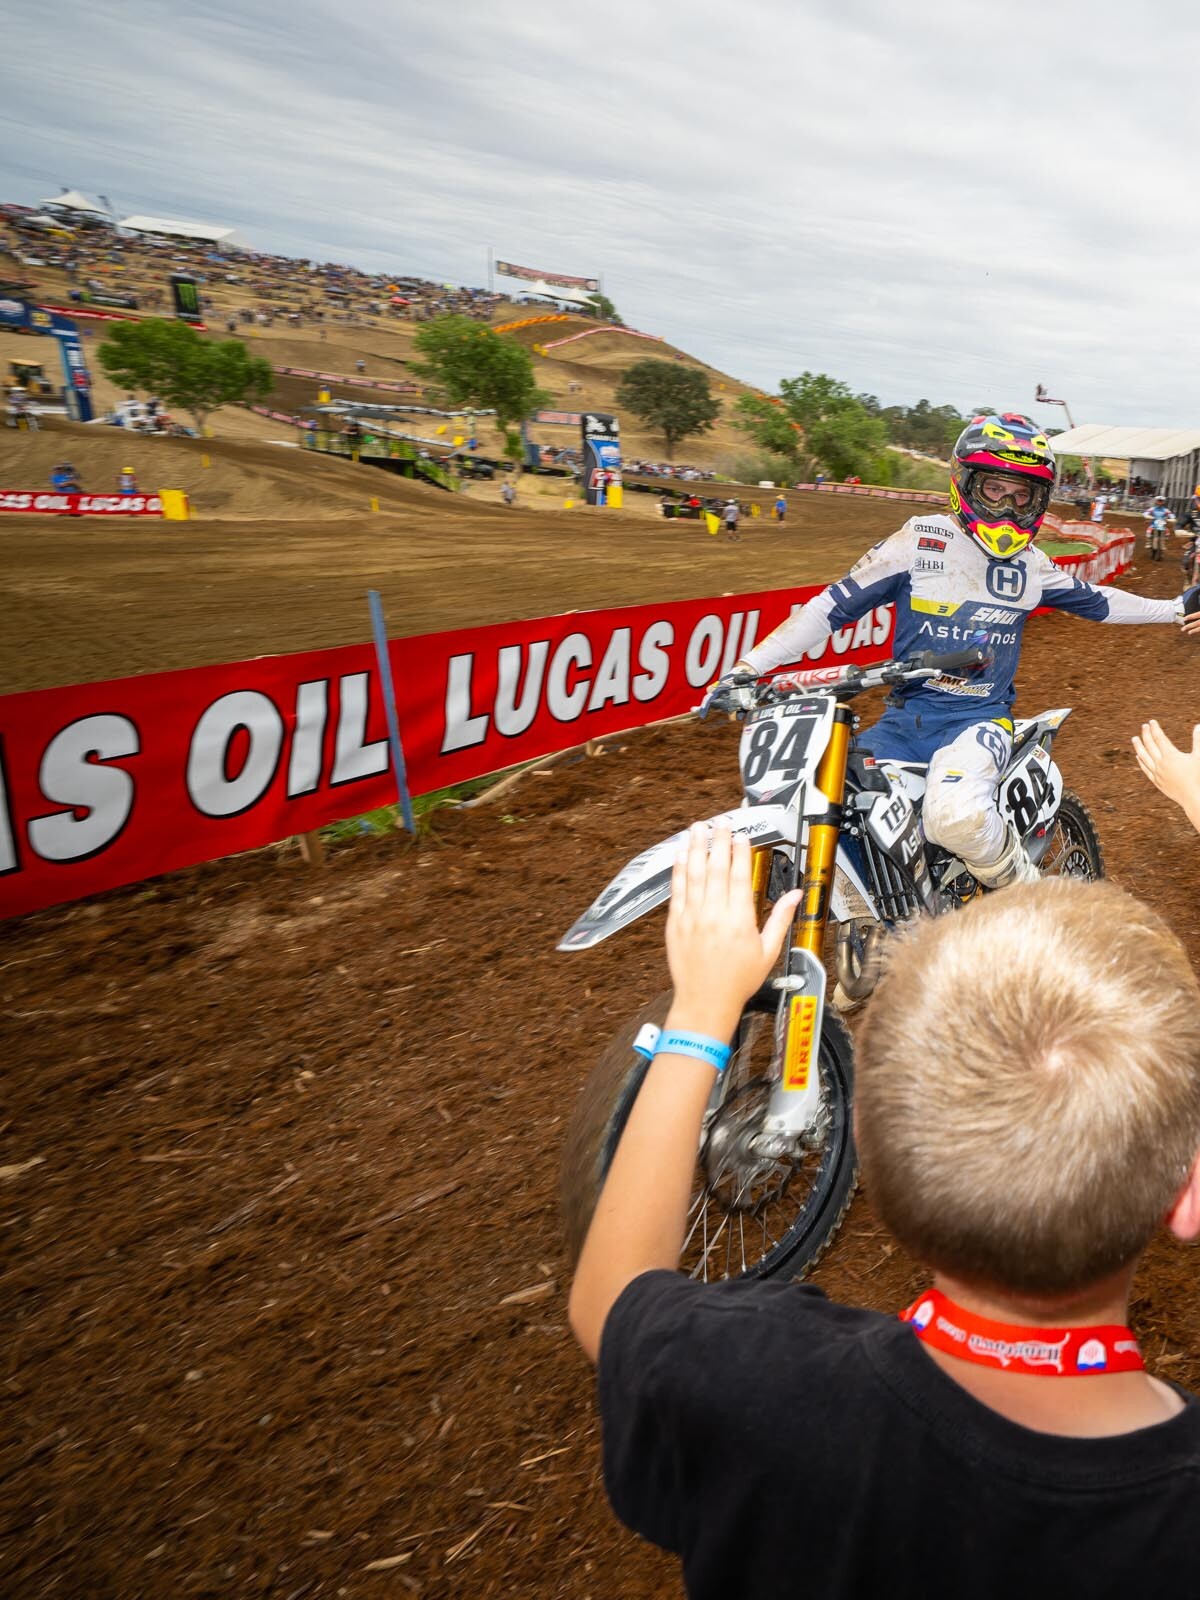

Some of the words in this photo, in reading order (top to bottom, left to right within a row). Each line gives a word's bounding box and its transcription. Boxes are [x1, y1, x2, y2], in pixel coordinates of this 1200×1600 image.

[78, 496, 145, 512] LUCAS
[921, 559, 945, 570] HBI
[970, 606, 1023, 625] SHOT
[0, 712, 142, 879] S
[185, 671, 391, 821] OIL
[440, 618, 673, 755] LUCAS
[744, 717, 818, 787] 84
[1006, 756, 1057, 838] 84
